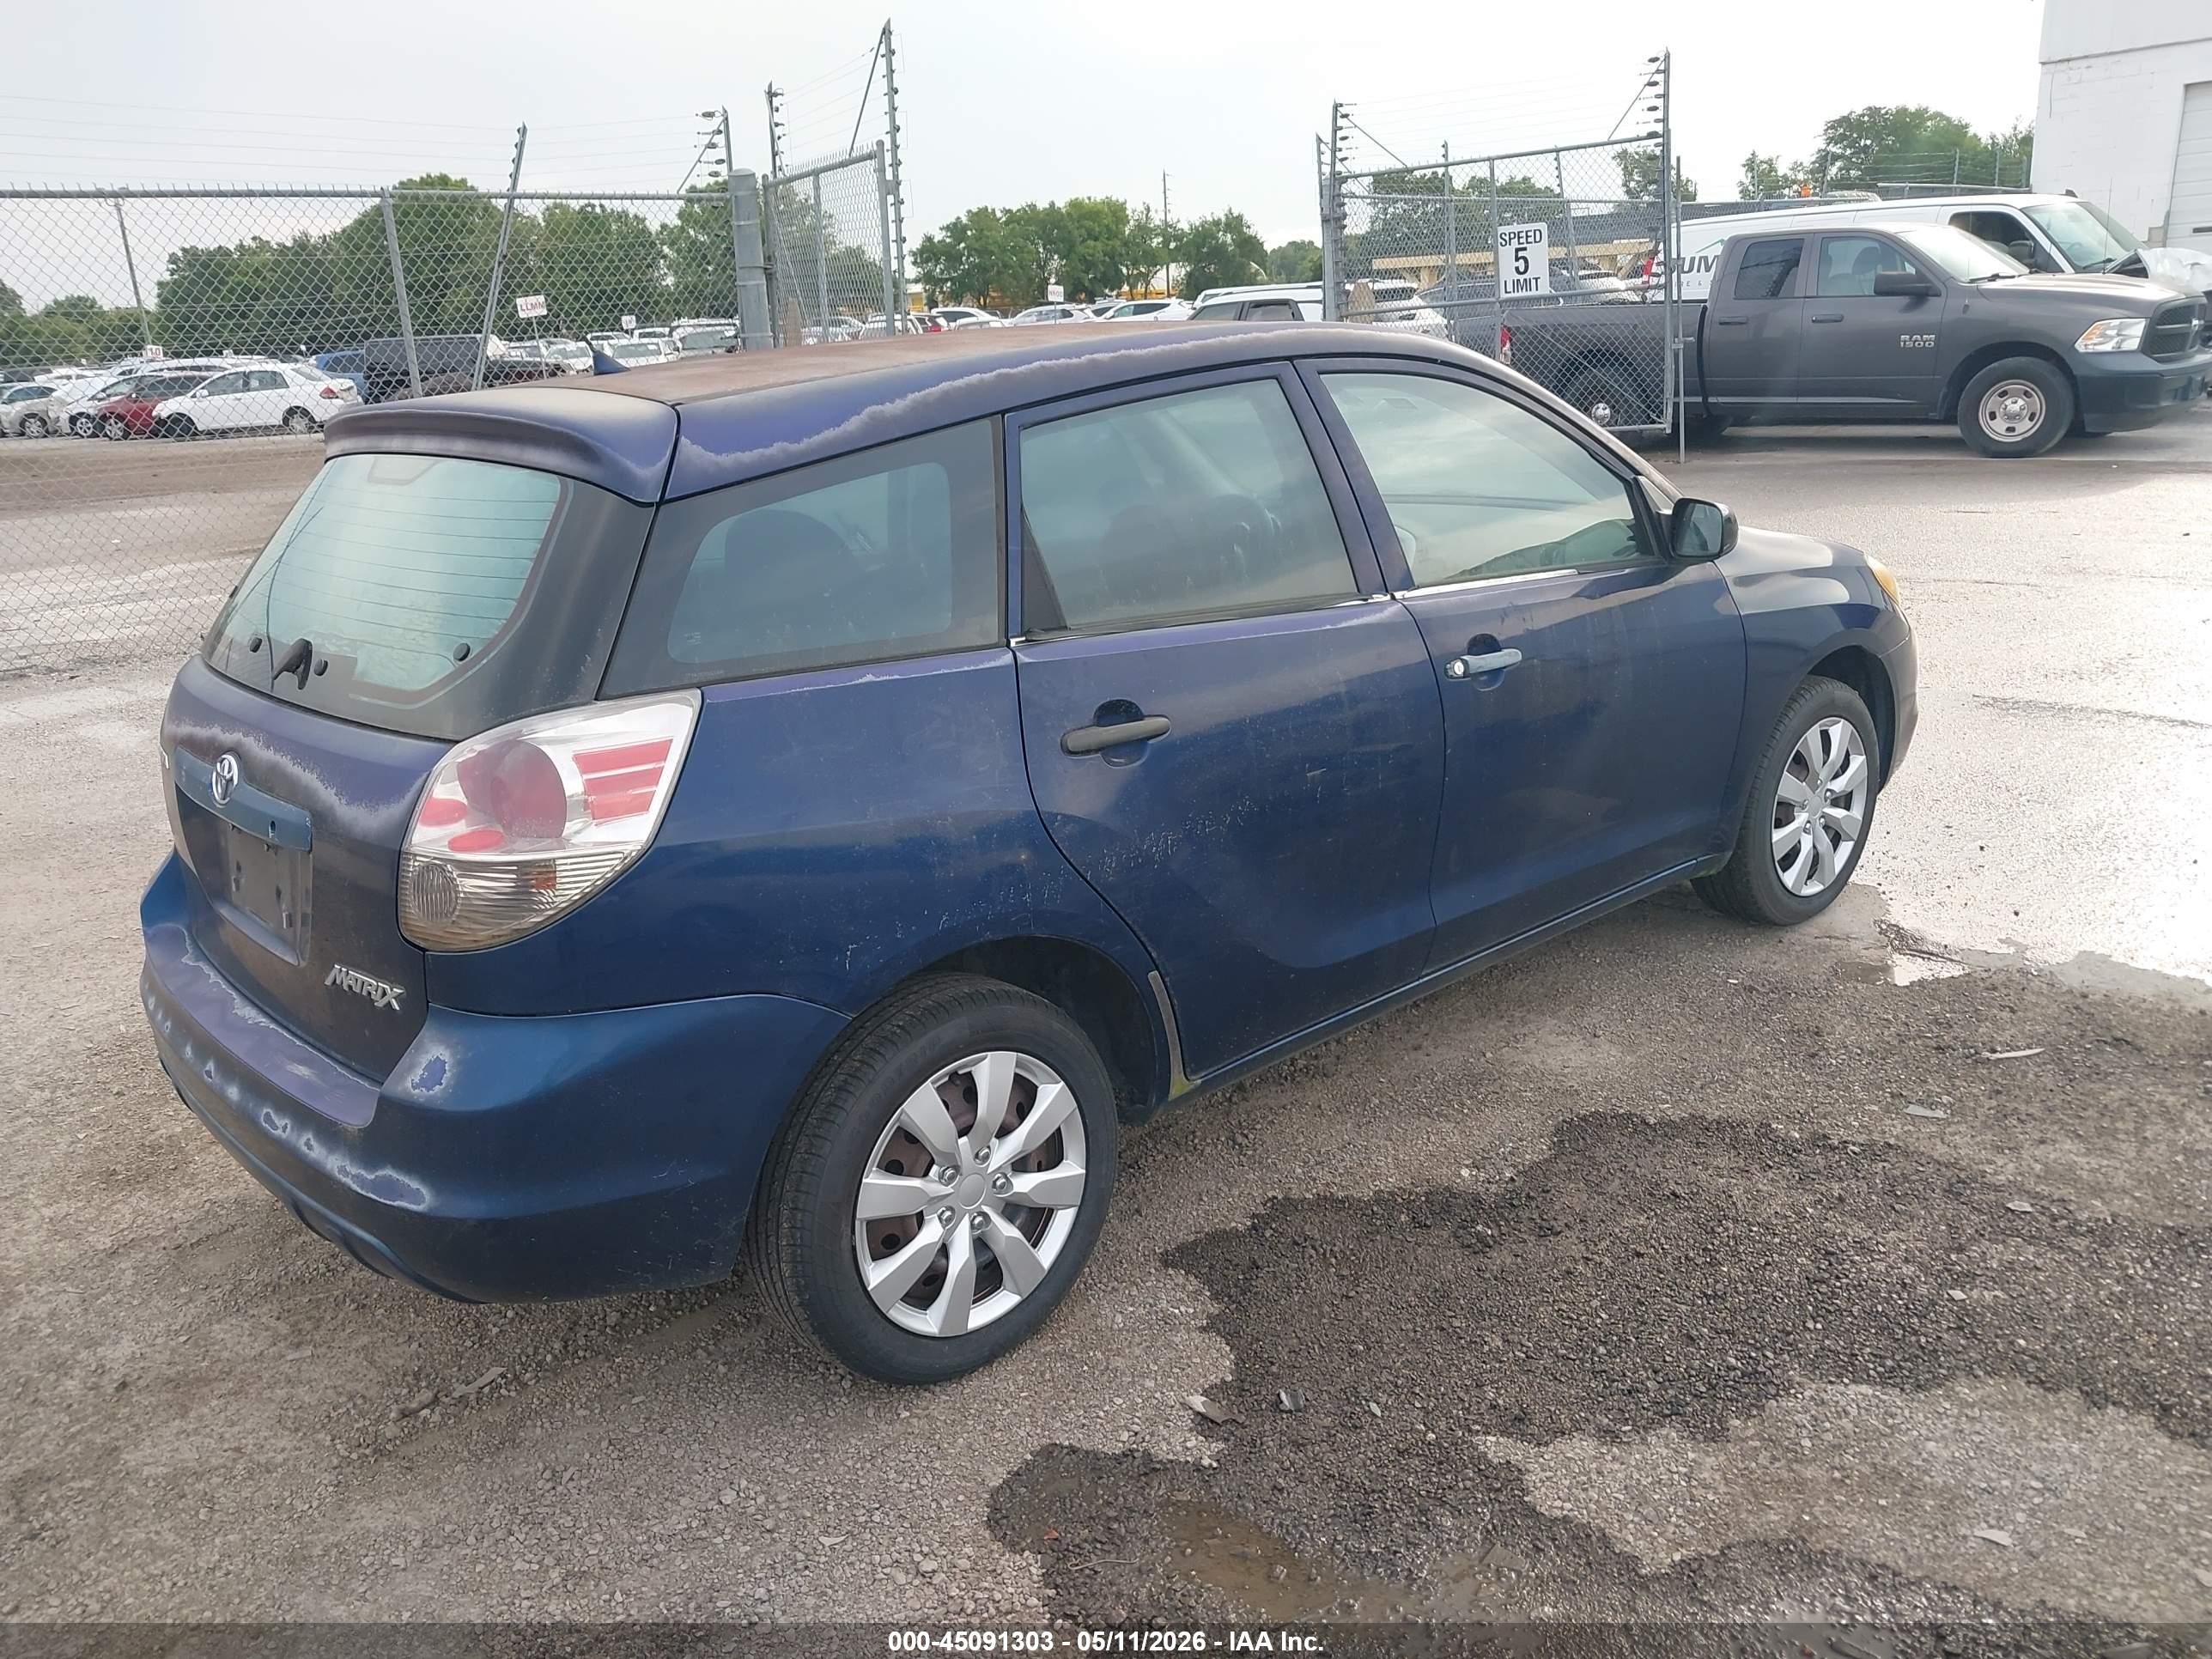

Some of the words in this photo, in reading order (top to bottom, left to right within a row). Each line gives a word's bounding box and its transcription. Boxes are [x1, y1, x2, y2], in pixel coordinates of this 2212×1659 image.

[1499, 228, 1542, 247] SPEED
[1514, 246, 1529, 276] 5
[1504, 276, 1541, 294] LIMIT
[324, 963, 404, 1011] MATRIX
